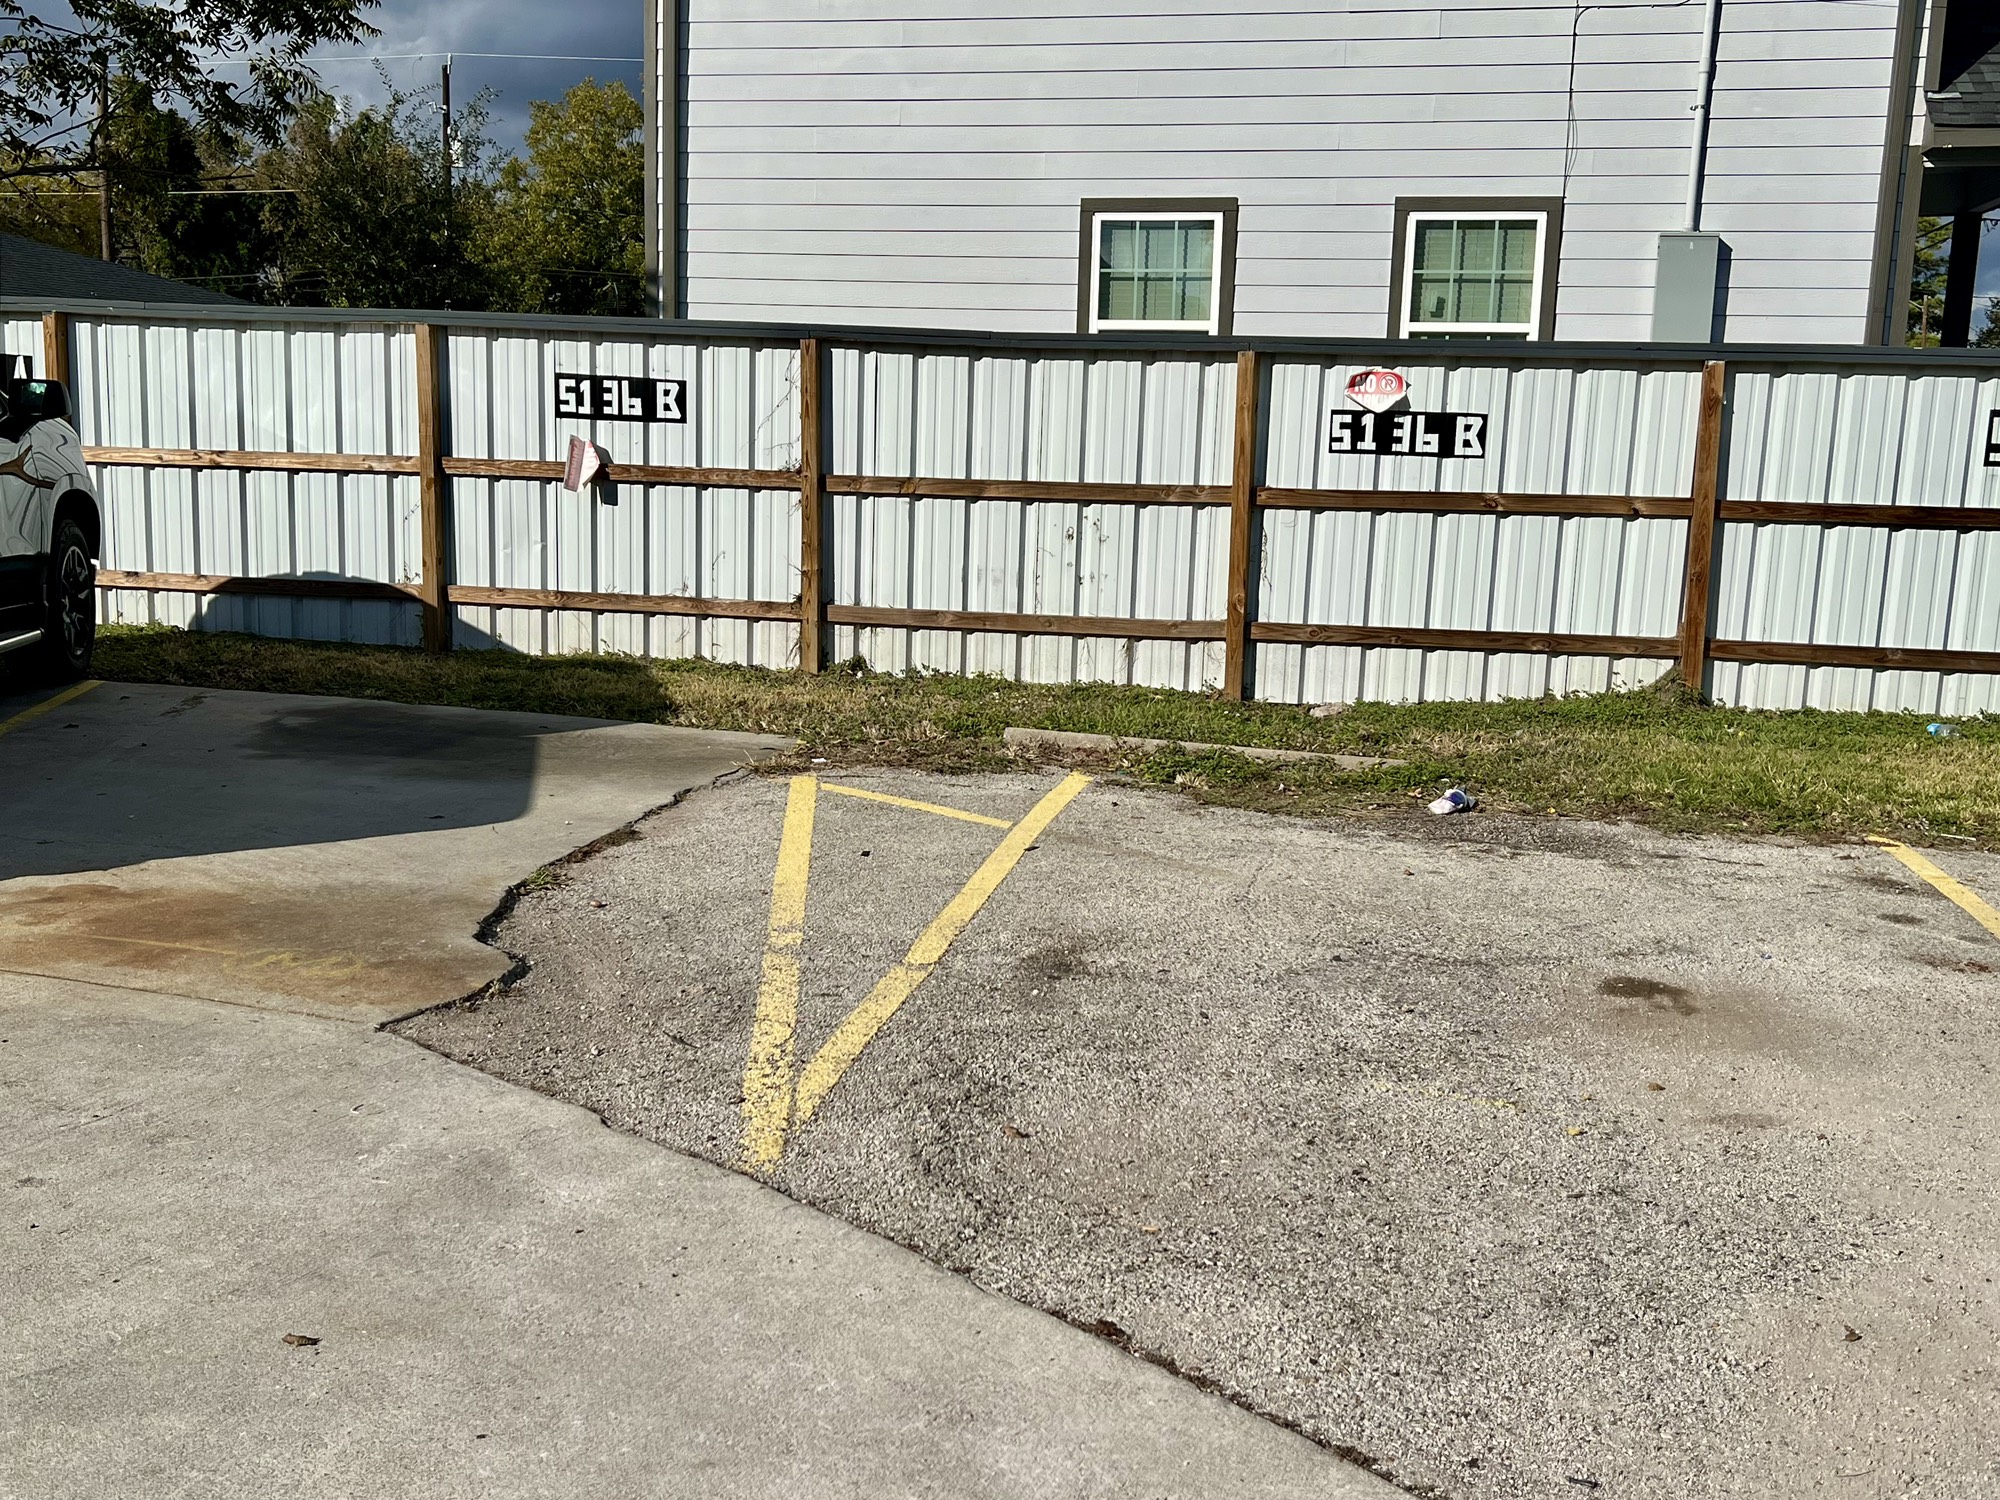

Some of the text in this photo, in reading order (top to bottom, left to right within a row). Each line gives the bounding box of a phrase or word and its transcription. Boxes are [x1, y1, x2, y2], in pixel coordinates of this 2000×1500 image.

[656, 381, 682, 419] B
[1354, 374, 1377, 393] NO
[1454, 415, 1484, 456] B
